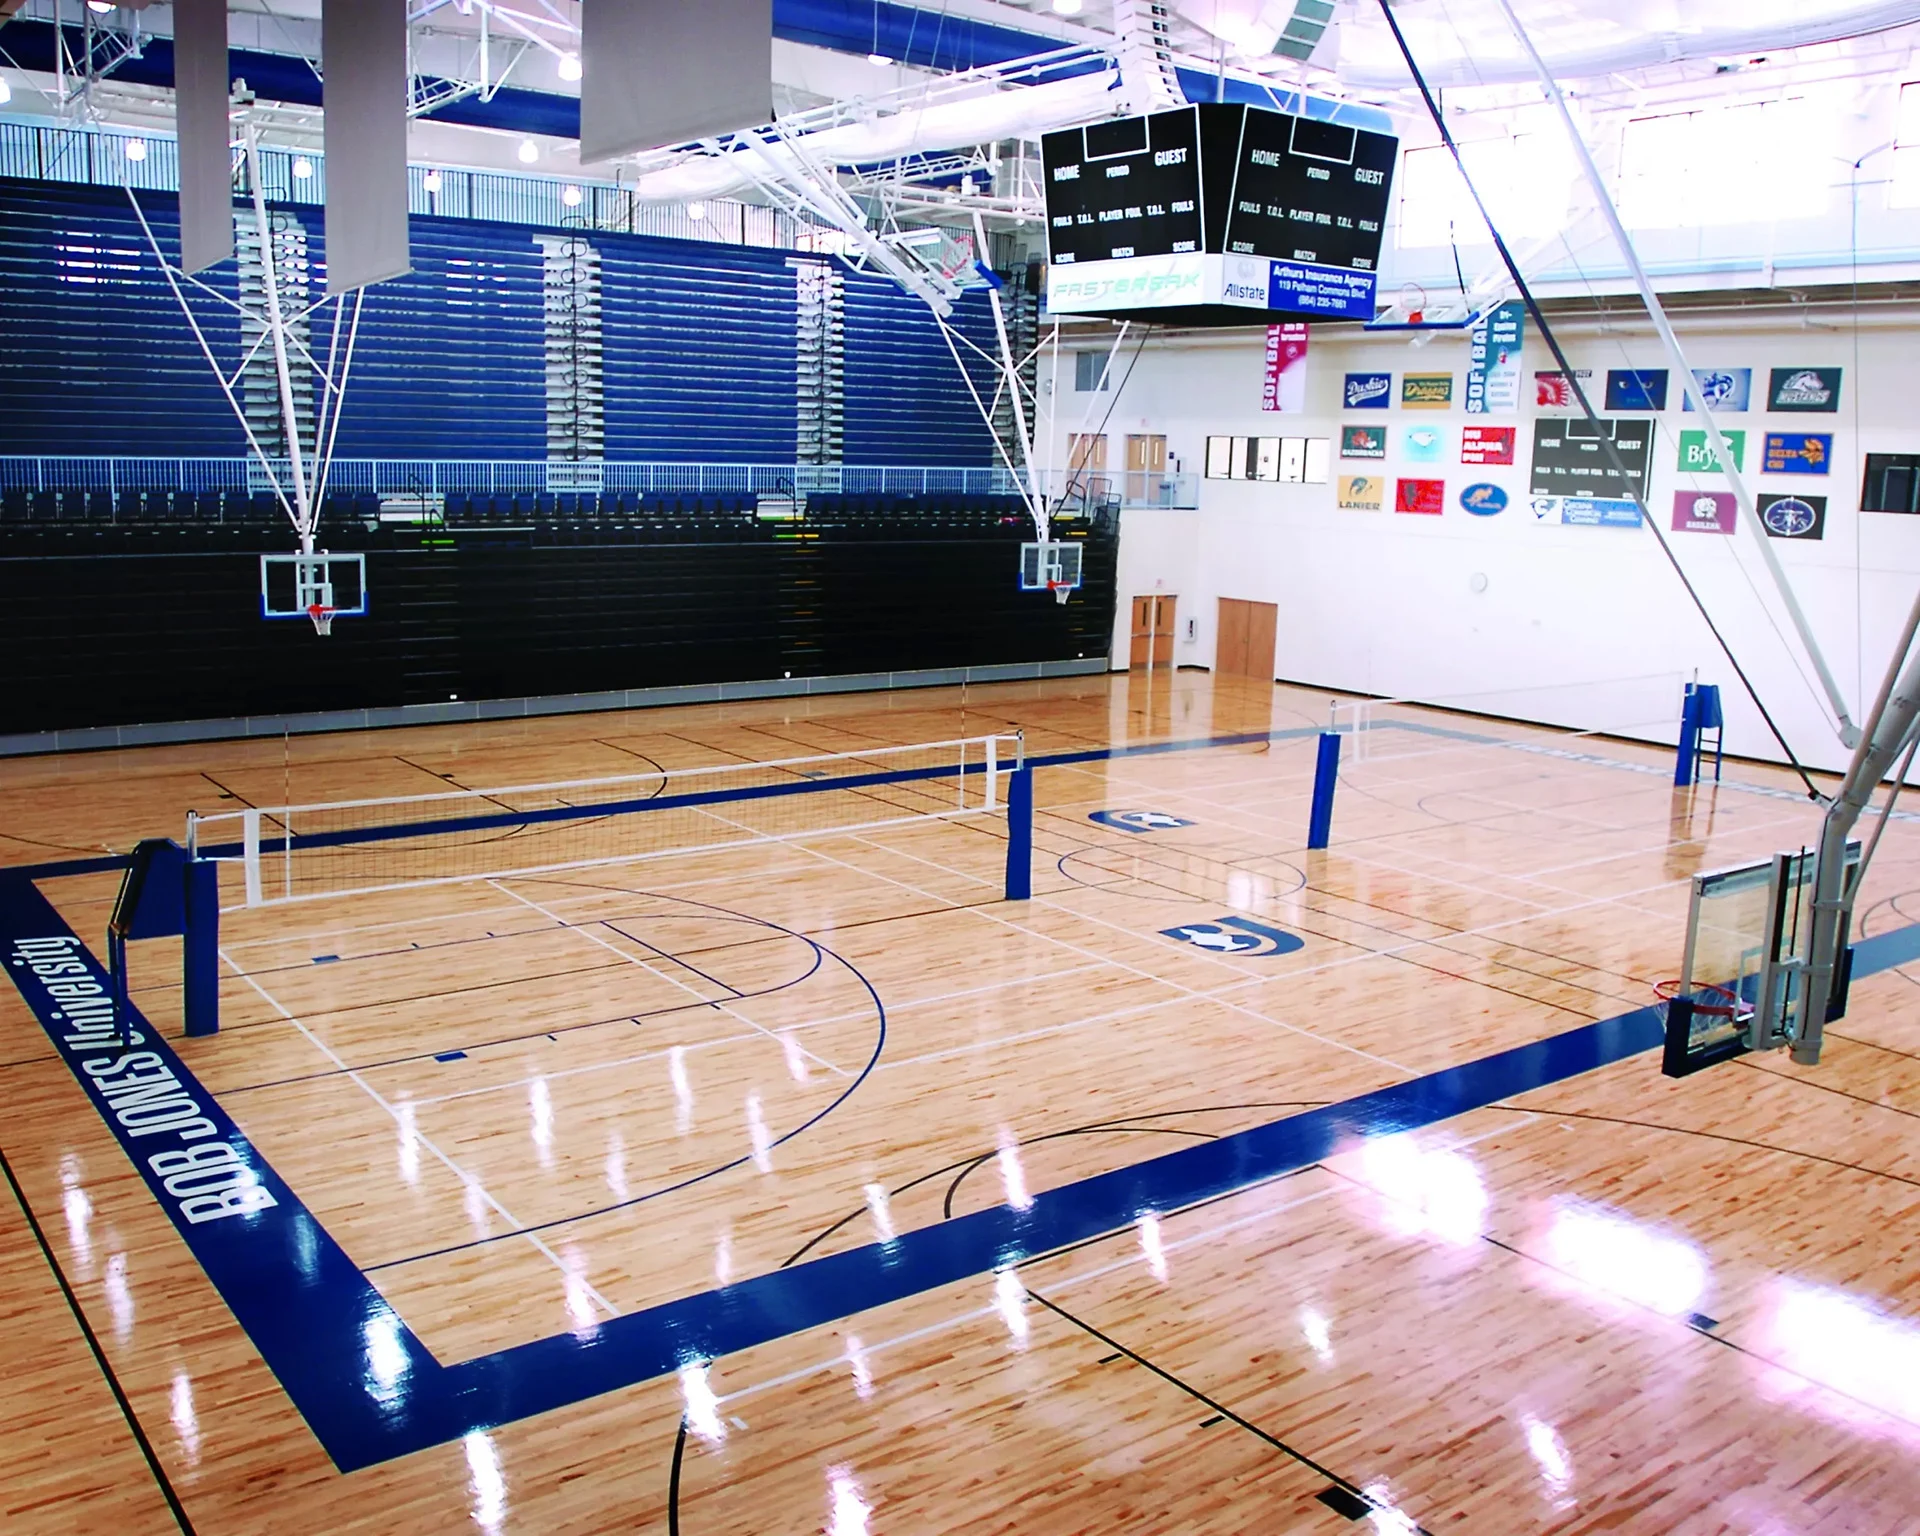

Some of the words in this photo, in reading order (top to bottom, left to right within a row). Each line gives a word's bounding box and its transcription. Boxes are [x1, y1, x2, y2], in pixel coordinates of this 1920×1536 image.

[1154, 148, 1187, 166] GUEST
[1251, 149, 1281, 167] HOME
[1053, 165, 1080, 182] HOME
[1354, 167, 1385, 186] GUEST
[1098, 209, 1124, 222] PLAYER
[1171, 200, 1195, 213] FOULS
[1239, 201, 1261, 214] FOULS
[1289, 208, 1314, 222] PLAYER
[1315, 213, 1331, 225] FOUL
[1358, 220, 1379, 232] FOULS
[1305, 269, 1343, 284] Insurance
[1344, 274, 1373, 290] Agency
[1224, 283, 1265, 301] Allstate
[1318, 284, 1350, 297] Commons
[1263, 324, 1280, 410] SOFTBAL
[1467, 317, 1489, 413] SOFTBAL
[1463, 441, 1504, 452] ALPHA
[82, 1051, 218, 1140] JONES
[147, 1141, 279, 1224] BOB
